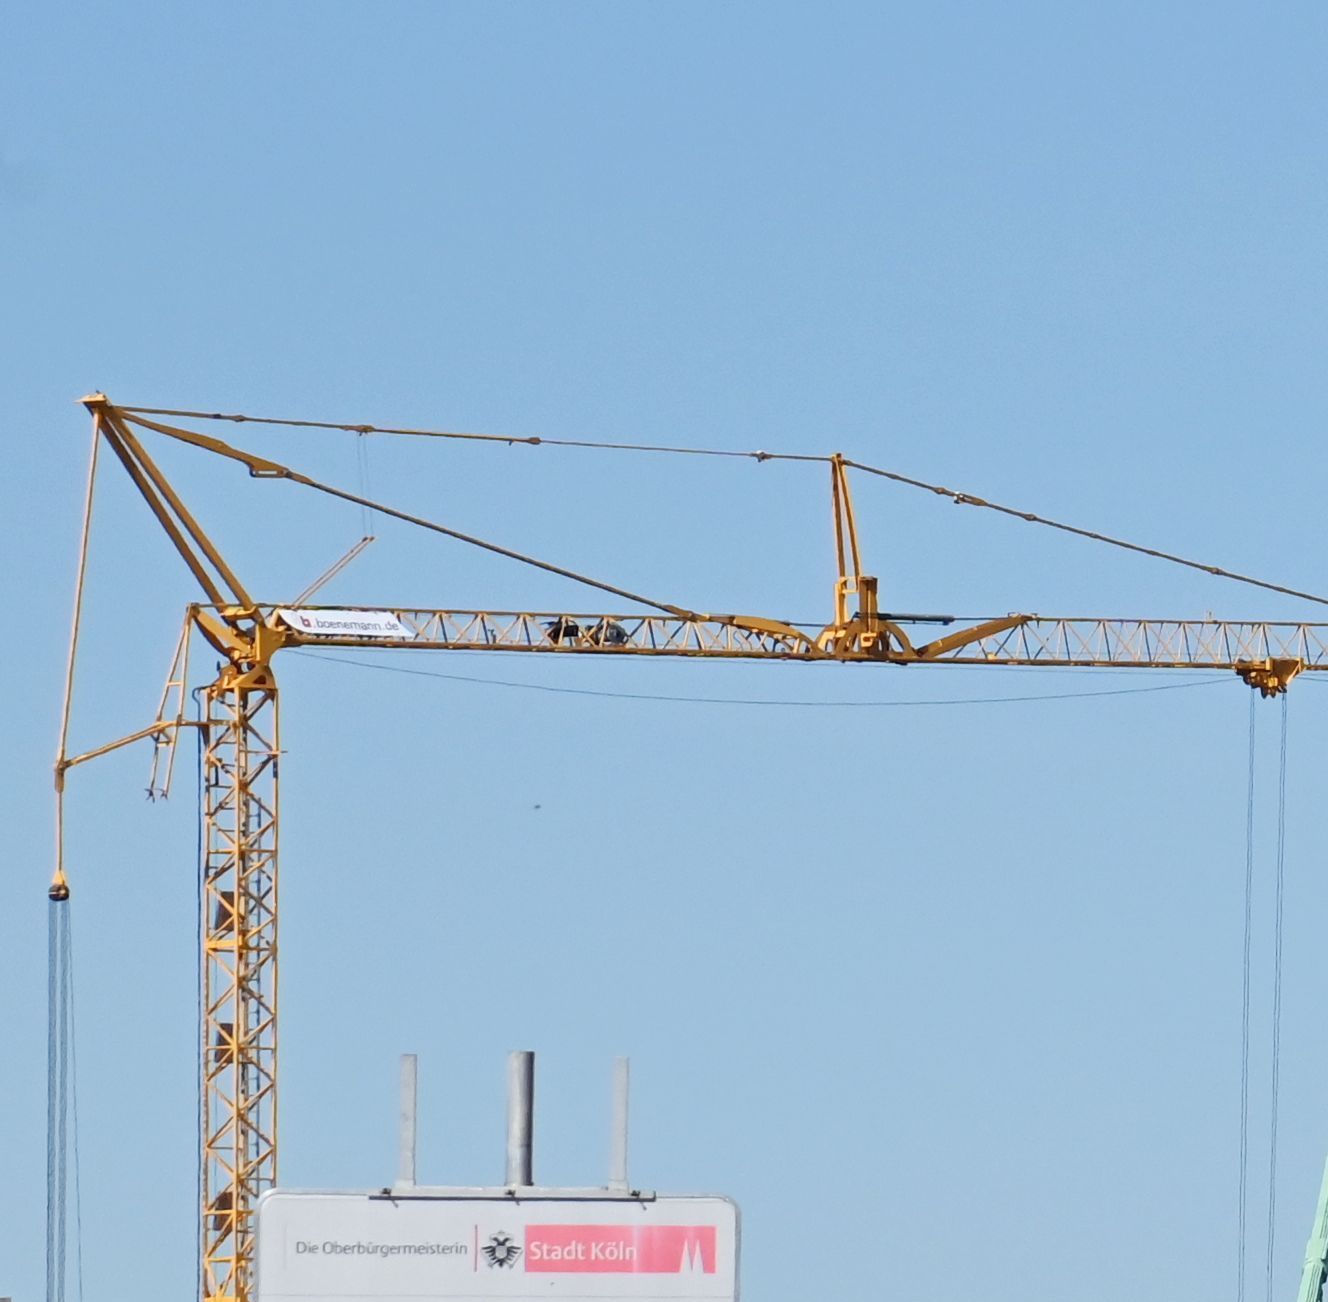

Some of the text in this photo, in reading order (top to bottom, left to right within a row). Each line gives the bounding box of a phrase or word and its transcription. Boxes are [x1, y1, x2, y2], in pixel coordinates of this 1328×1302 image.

[296, 1241, 468, 1258] Die Oberbürgermeisterin
[529, 1239, 638, 1261] Stadt Köln
